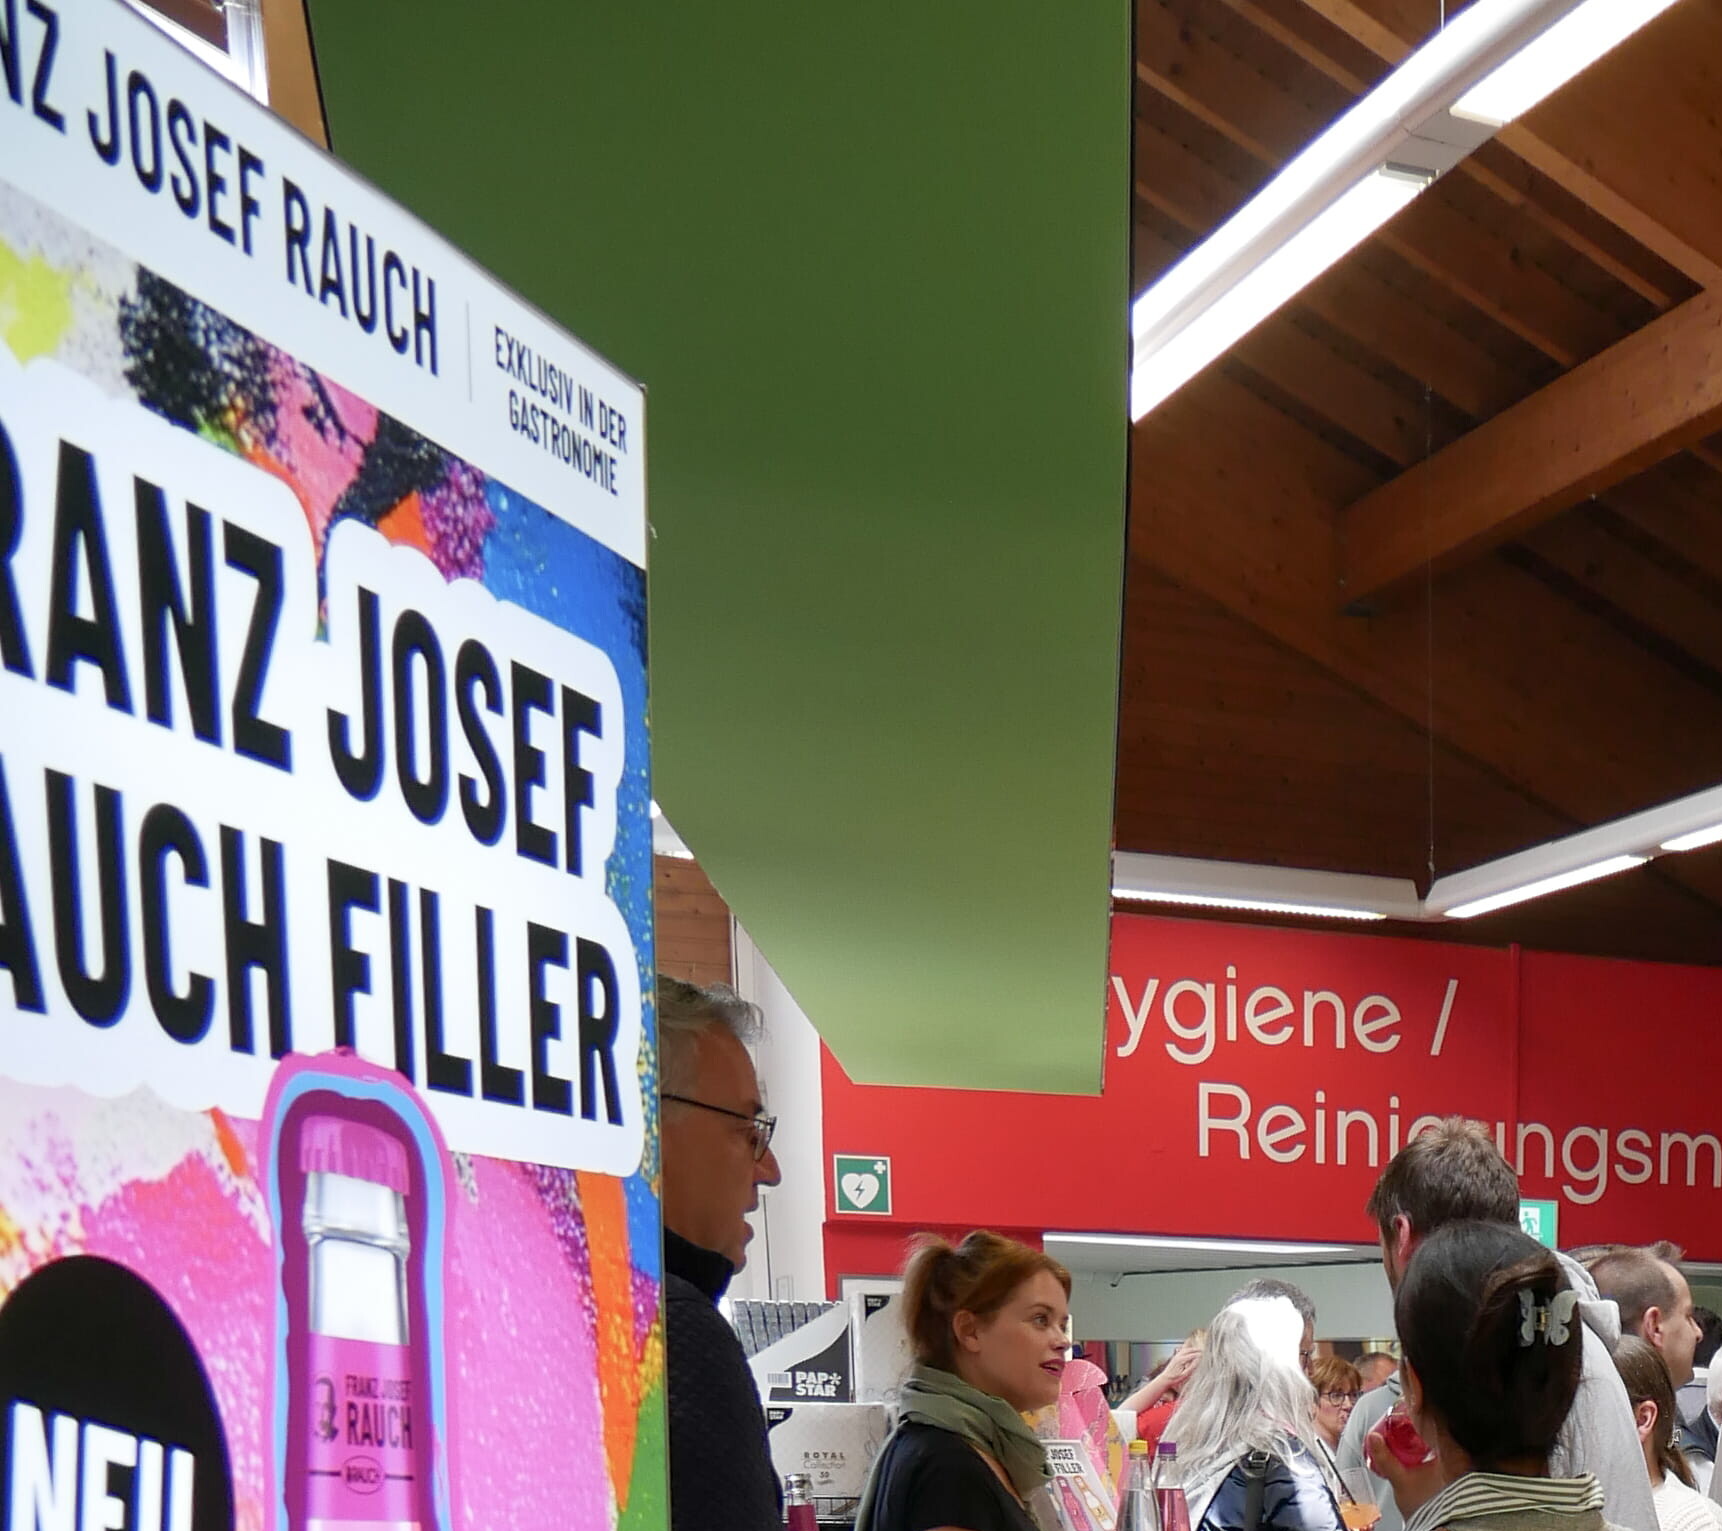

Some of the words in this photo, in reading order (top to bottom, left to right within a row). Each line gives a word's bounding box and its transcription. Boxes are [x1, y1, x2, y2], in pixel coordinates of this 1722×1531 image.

[87, 48, 265, 257] JOSEF
[282, 176, 440, 378] RAUCH
[494, 325, 573, 416] EXKLUSIV
[578, 374, 594, 425] IN
[599, 386, 628, 455] DER
[508, 389, 619, 498] GASTRONOMIE
[326, 585, 603, 879] JOSEF
[326, 857, 625, 1127] FILLER
[347, 1402, 414, 1450] RAUCH
[795, 1384, 837, 1397] STAR
[1055, 1462, 1084, 1474] FILLER
